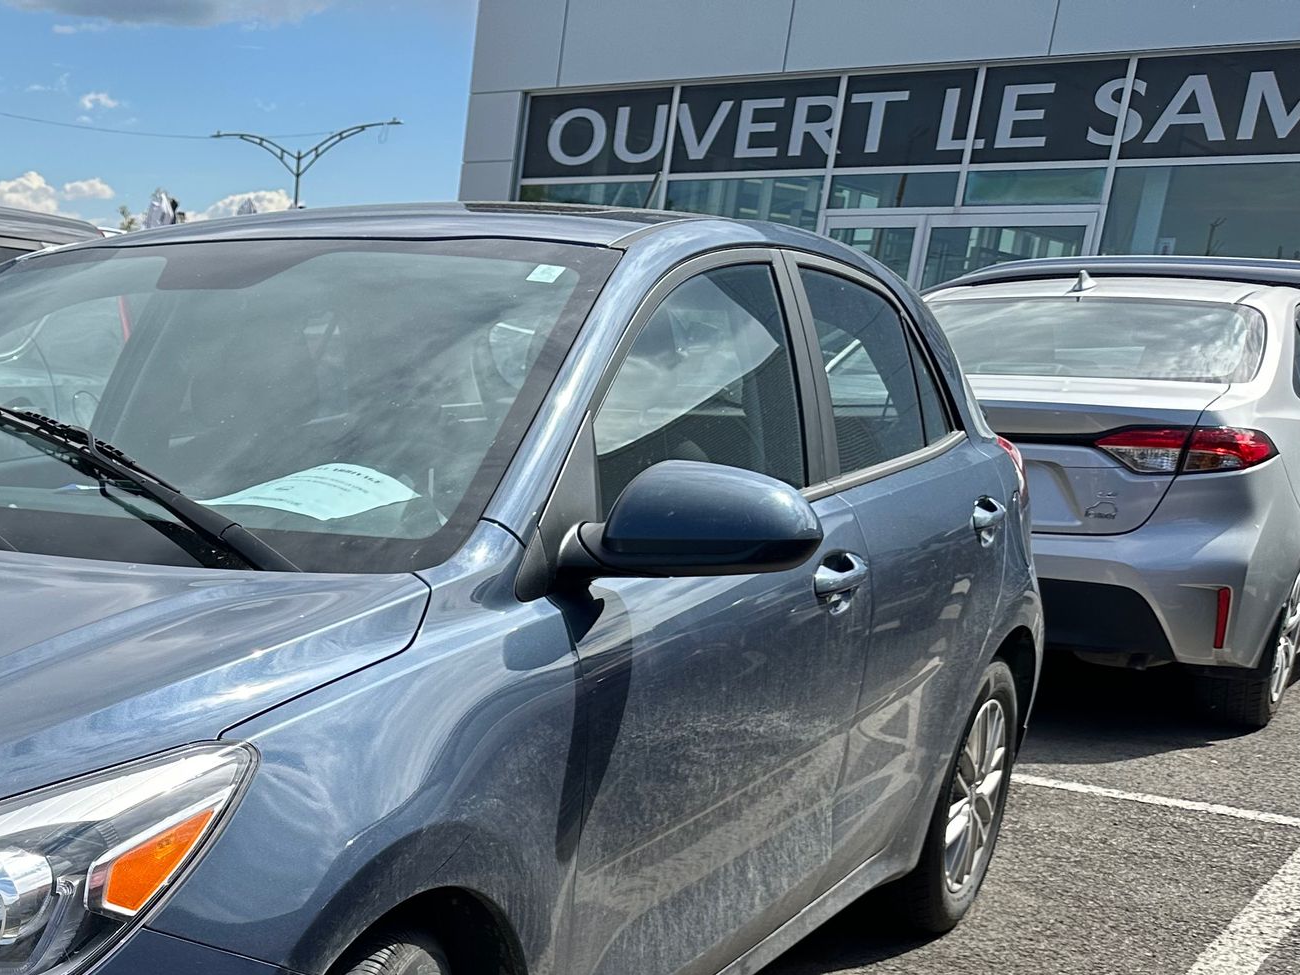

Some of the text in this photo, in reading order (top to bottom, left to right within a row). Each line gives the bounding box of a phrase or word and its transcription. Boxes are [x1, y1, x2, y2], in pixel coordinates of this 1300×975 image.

[547, 71, 1300, 166] OUVERT LE SAM
